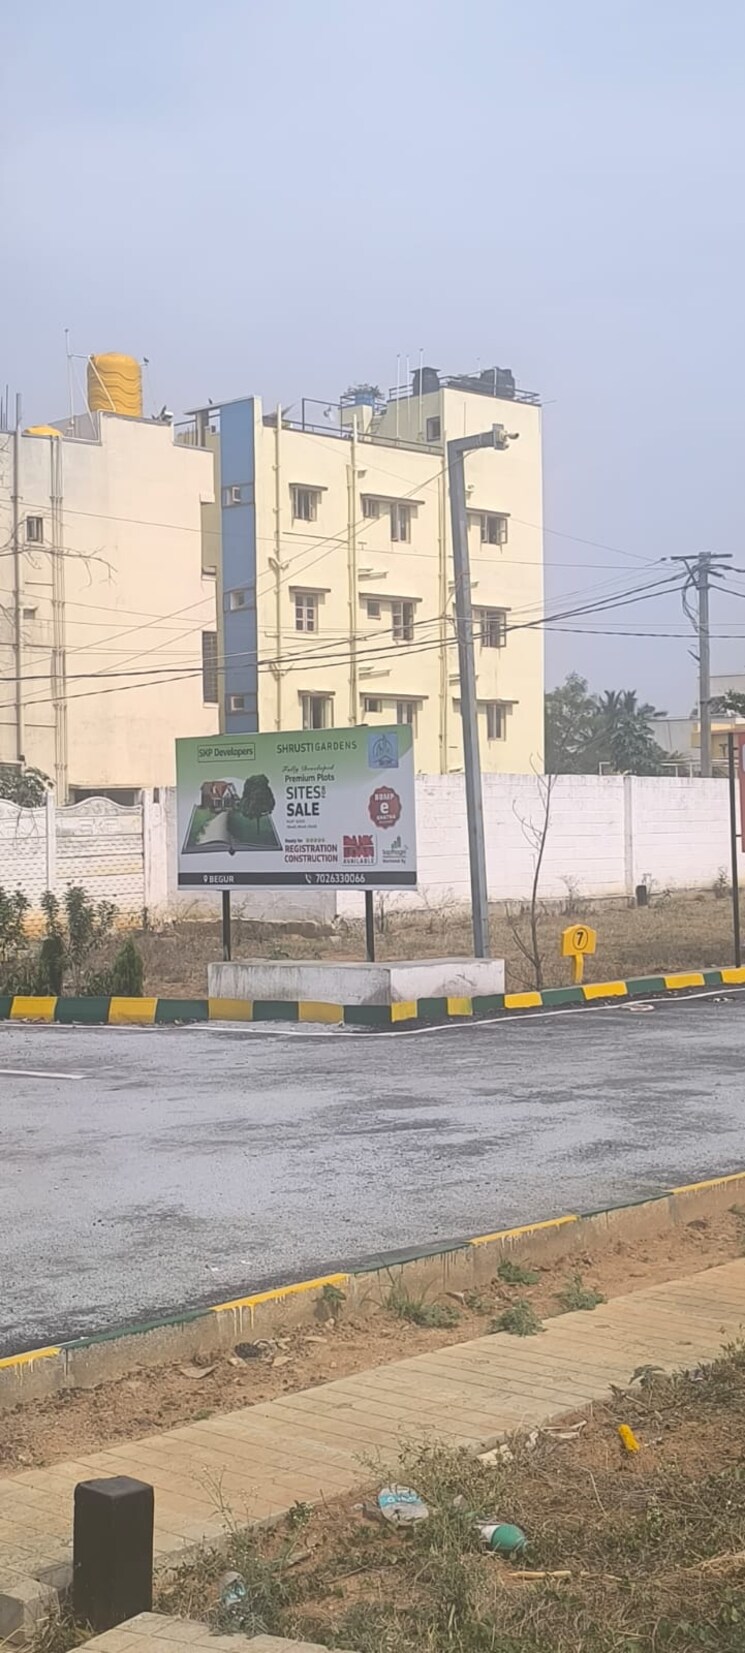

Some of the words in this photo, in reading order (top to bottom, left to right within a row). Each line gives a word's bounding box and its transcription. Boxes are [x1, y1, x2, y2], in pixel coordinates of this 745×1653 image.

[214, 746, 254, 758] Developers
[284, 773, 316, 783] Premium
[316, 773, 336, 782] Plots
[286, 785, 321, 800] SITES
[286, 802, 320, 817] SALE
[380, 802, 389, 814] e
[284, 844, 338, 853] REGISTRATION
[284, 854, 338, 863] CONSTRUCTION
[209, 875, 234, 884] BEGUR
[315, 873, 365, 883] 7026330066
[577, 931, 584, 946] 7
